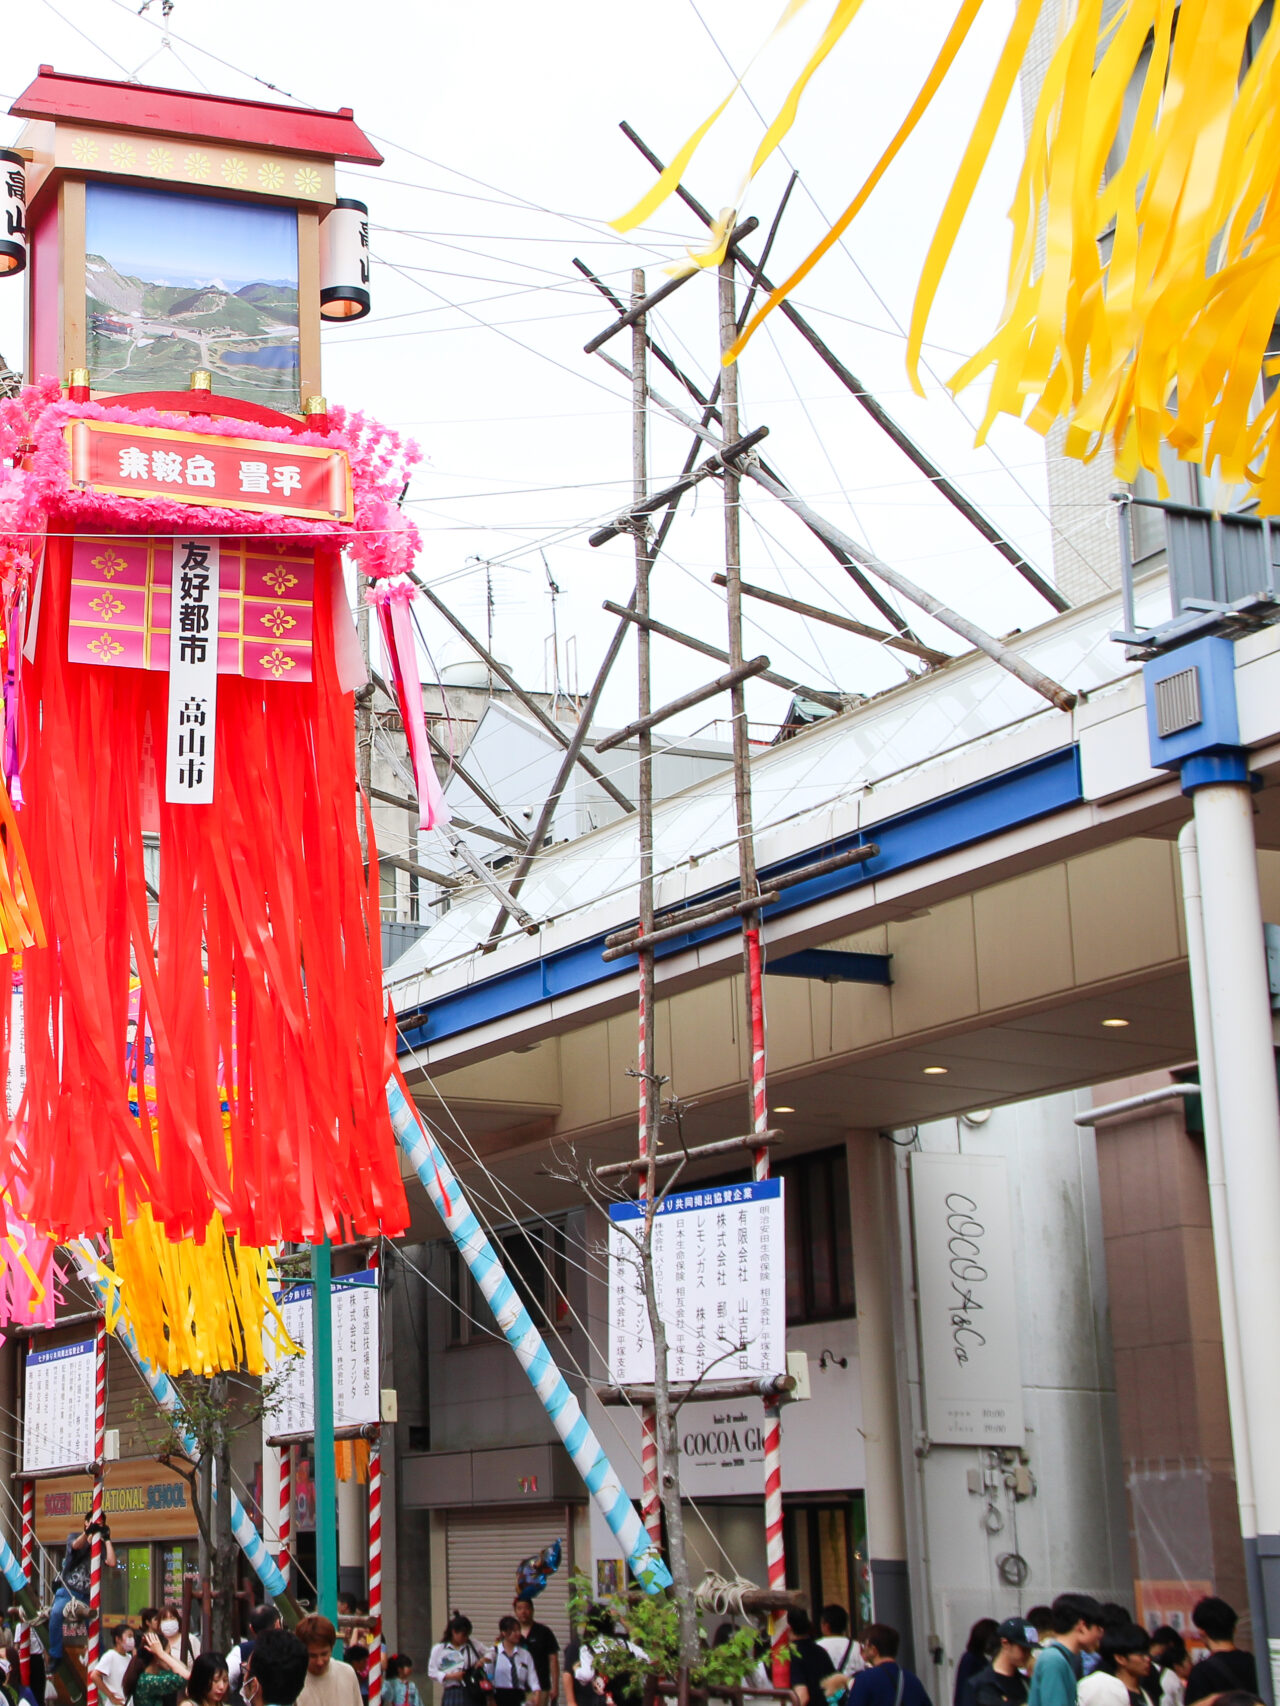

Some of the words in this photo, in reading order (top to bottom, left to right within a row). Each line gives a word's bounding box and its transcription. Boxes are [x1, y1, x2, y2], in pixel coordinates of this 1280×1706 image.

[118, 447, 217, 487] 乗鞍岳
[238, 459, 303, 497] 畳平
[179, 541, 211, 665] 友好都市
[176, 696, 208, 789] 高山市
[696, 1214, 706, 1289] レモンガス
[716, 1211, 727, 1287] 株式会社
[738, 1209, 749, 1283] 有限会社
[683, 1430, 742, 1456] COCOA
[146, 1482, 187, 1511] SCHOOL
